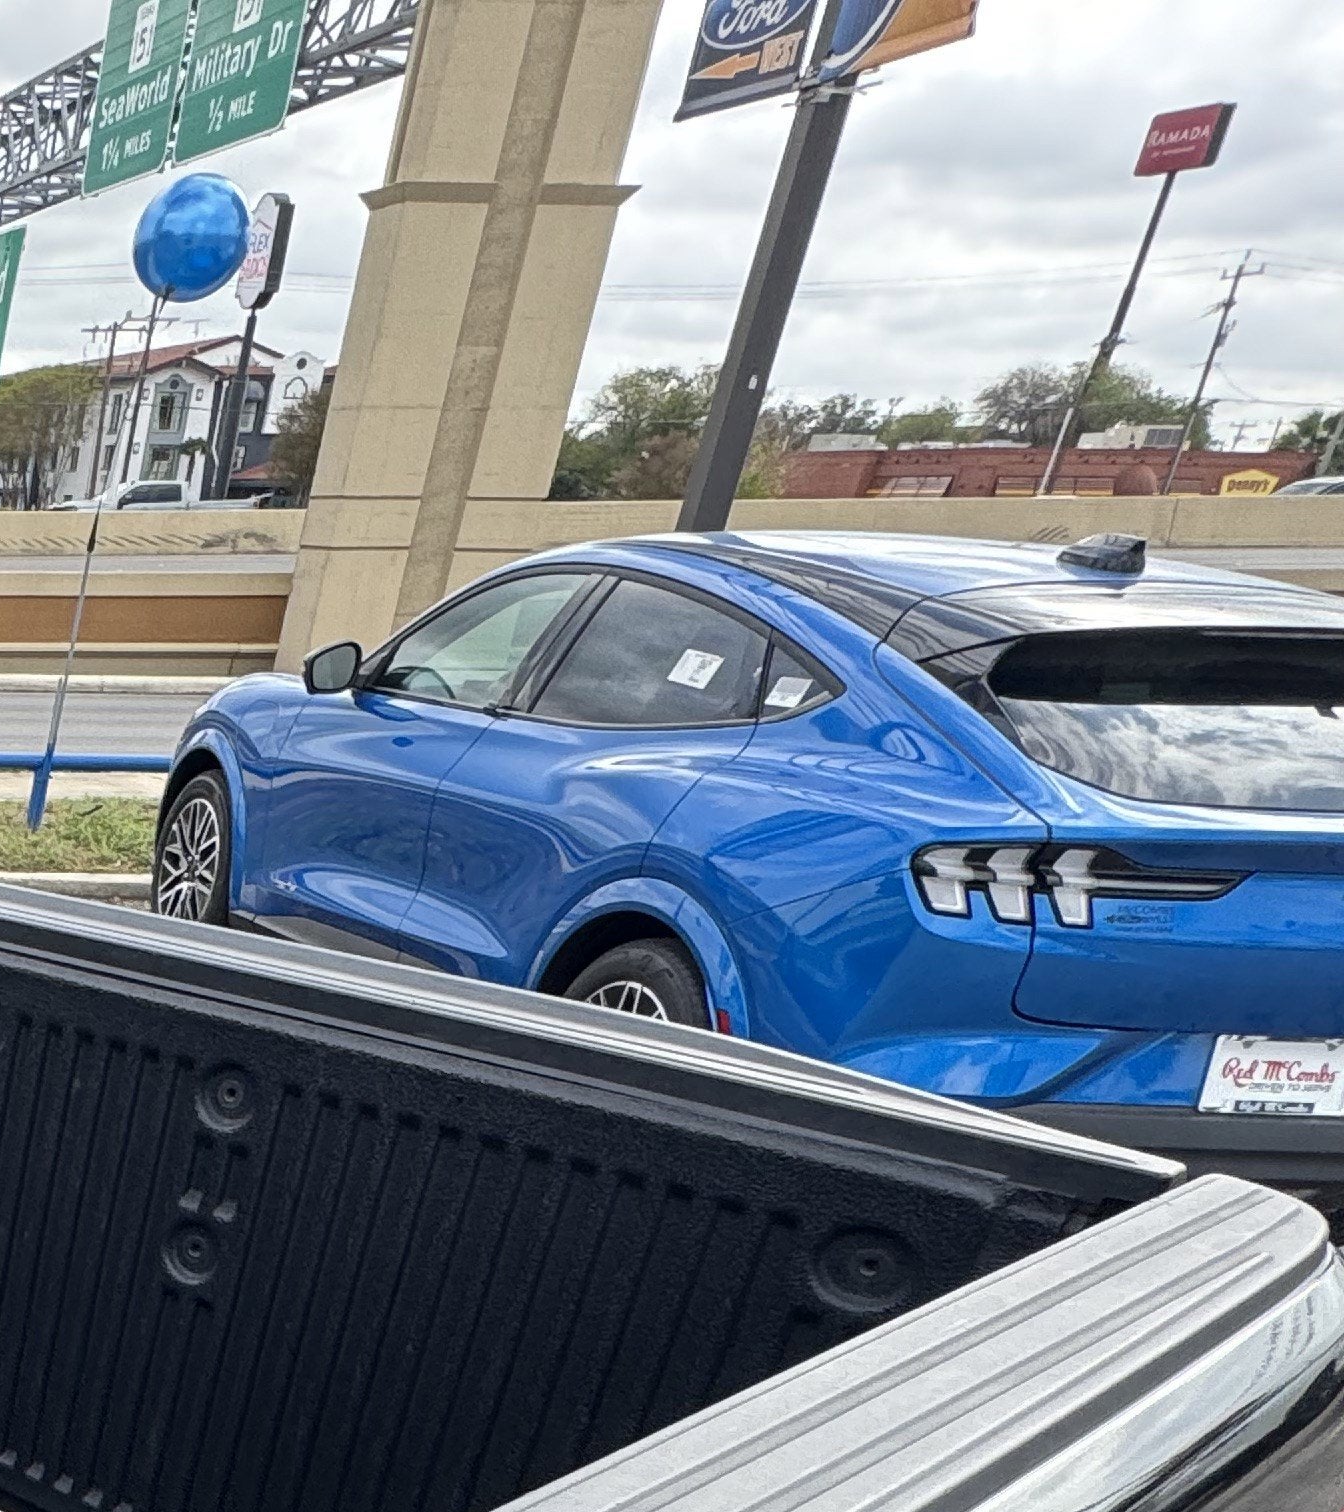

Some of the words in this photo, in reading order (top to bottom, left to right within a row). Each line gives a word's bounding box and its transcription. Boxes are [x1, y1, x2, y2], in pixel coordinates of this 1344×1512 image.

[718, 0, 790, 39] Ford
[193, 35, 262, 92] Military
[267, 20, 294, 59] Dr
[759, 29, 806, 74] WEST
[98, 65, 172, 129] SeaWorld
[228, 90, 257, 122] MILE
[123, 129, 152, 159] MILES
[1147, 124, 1210, 148] RAMADA
[1221, 1057, 1259, 1088] Red
